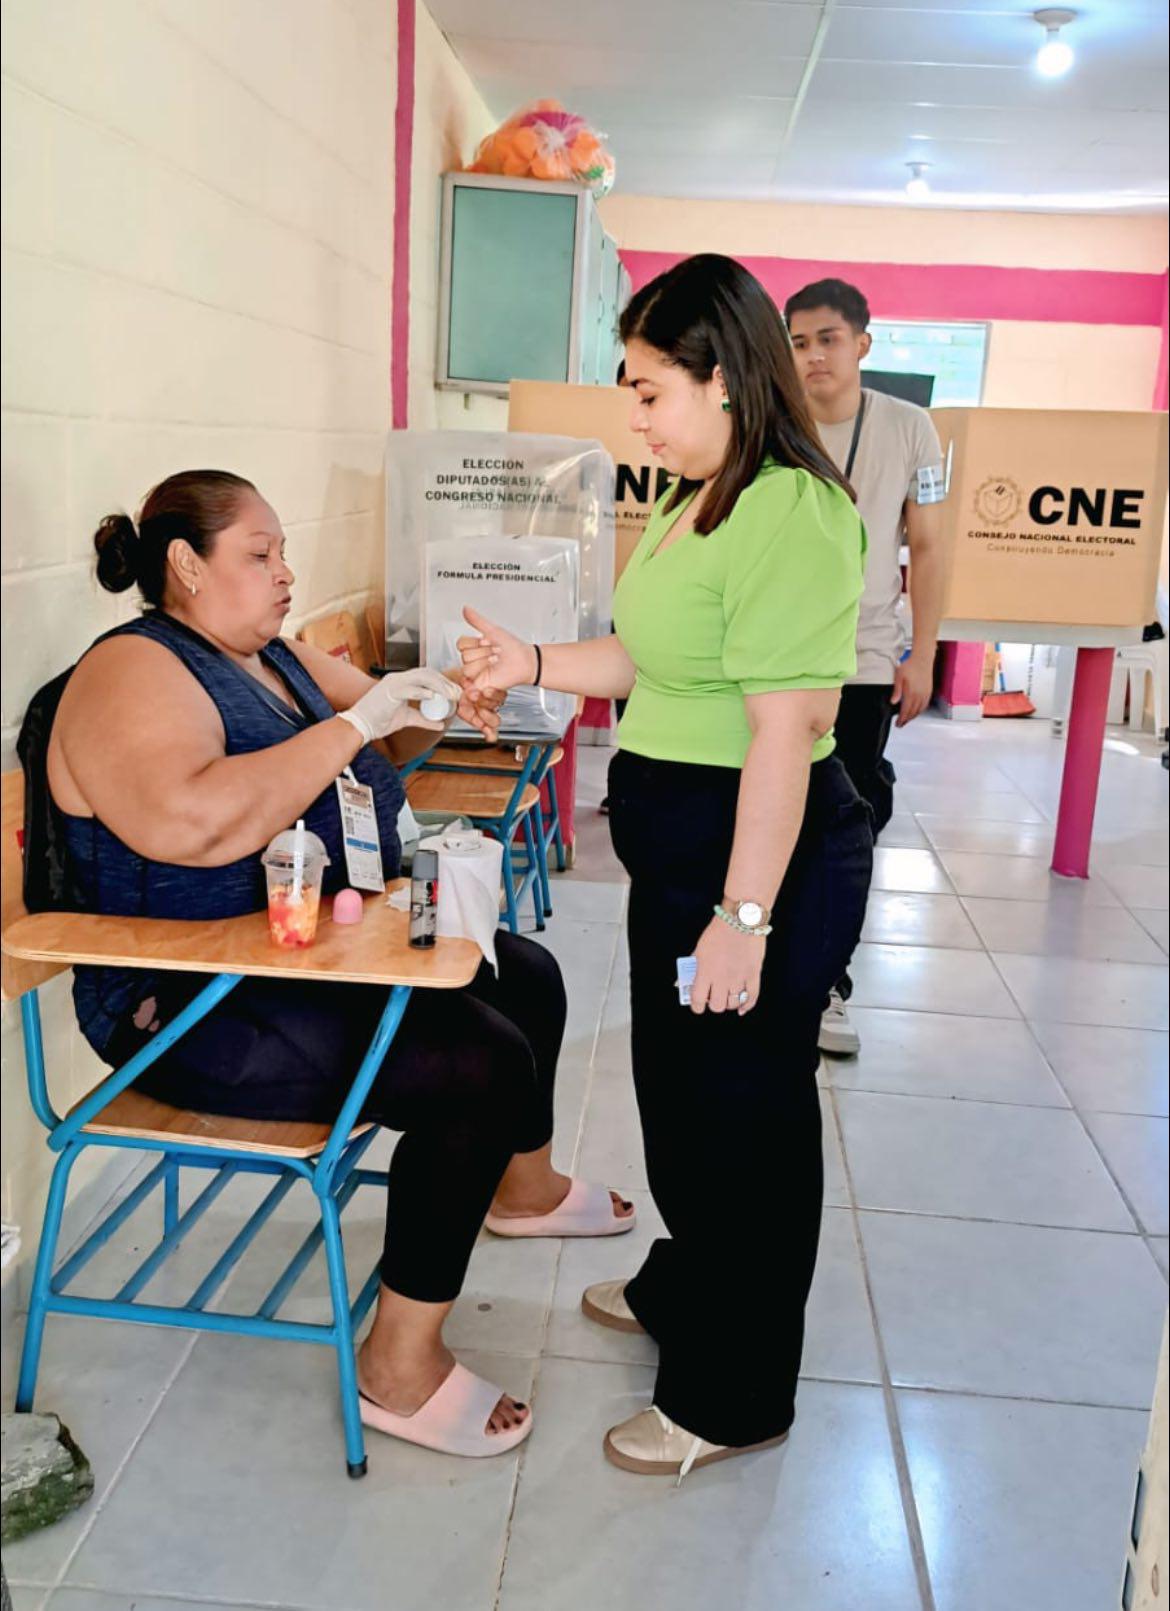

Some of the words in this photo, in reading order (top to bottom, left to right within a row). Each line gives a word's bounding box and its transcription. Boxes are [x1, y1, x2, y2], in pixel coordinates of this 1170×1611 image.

[425, 490, 494, 502] CONGRESO
[1028, 486, 1145, 528] CNE
[967, 531, 1016, 540] CONSEJO
[1019, 533, 1073, 542] NACIONAL
[1076, 535, 1137, 545] ELECTORAL
[486, 573, 557, 583] PRESIDENCIAL
